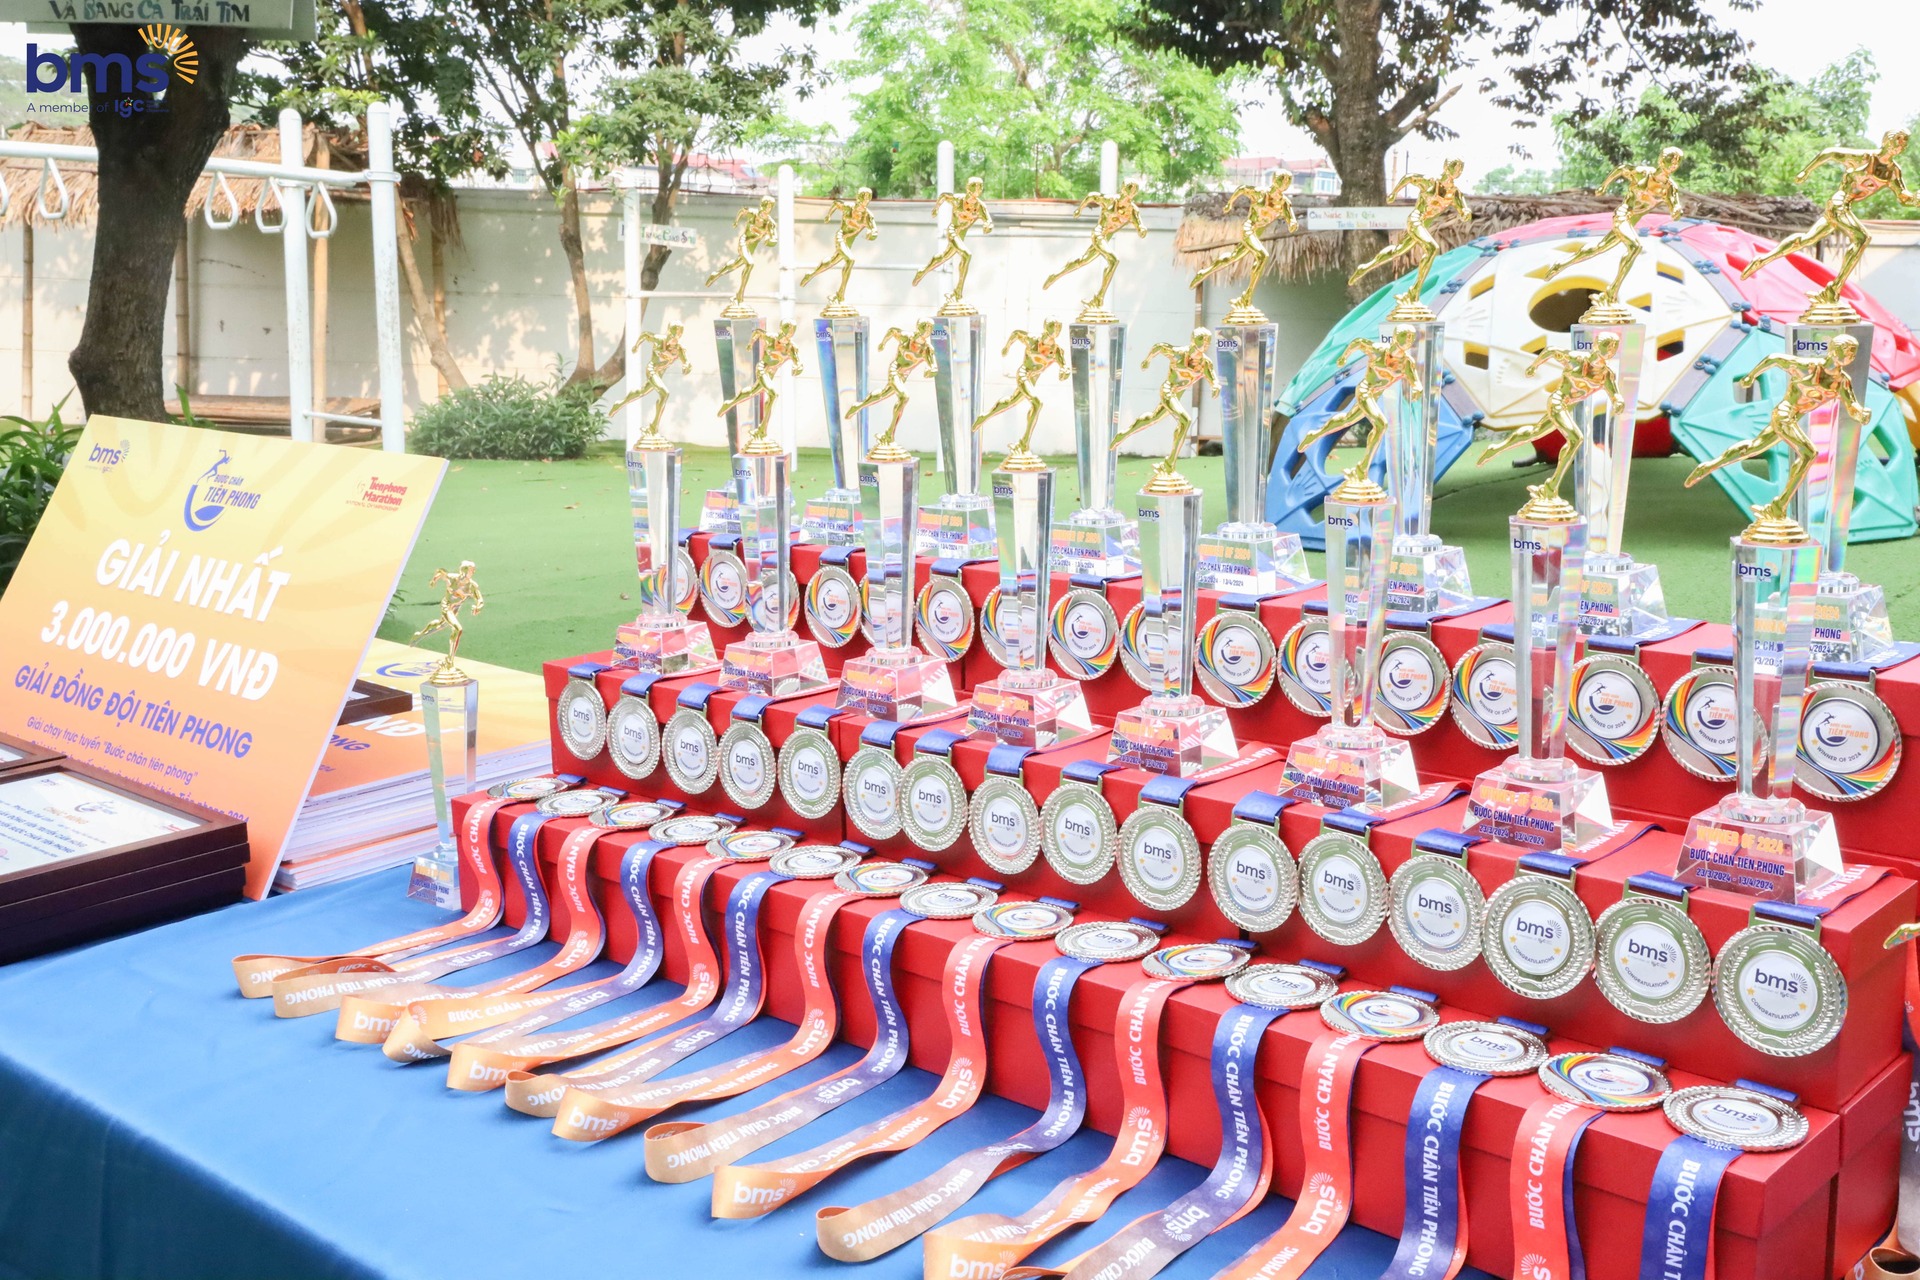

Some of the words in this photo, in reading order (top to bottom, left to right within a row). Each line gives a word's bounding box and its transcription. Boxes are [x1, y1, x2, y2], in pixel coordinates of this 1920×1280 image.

[1072, 336, 1090, 345] bms
[1217, 338, 1238, 348] bms
[1797, 340, 1828, 350] bms
[88, 443, 122, 465] bms
[859, 474, 878, 483] bms
[993, 485, 1013, 495] bms
[203, 485, 228, 503] TIÊN
[225, 491, 261, 509] PHONG
[362, 490, 403, 506] Marathon
[1138, 508, 1160, 518] bms
[1328, 514, 1354, 527] bms
[1513, 538, 1542, 551] bms
[95, 529, 180, 598] GIẢI
[174, 545, 291, 623] NHẤT
[1738, 563, 1772, 579] bms
[1591, 601, 1614, 613] PHONG
[1814, 627, 1841, 640] PHONG
[41, 600, 197, 679] 3.000.000
[198, 639, 279, 701] VNĐ
[15, 662, 53, 695] GIẢI
[51, 668, 104, 711] ĐỒNG
[104, 690, 141, 727] ĐỘI
[140, 700, 181, 735] TIÊN
[179, 714, 252, 758] PHONG
[573, 708, 590, 721] bms
[1588, 713, 1607, 729] WINNER
[1615, 720, 1627, 729] 2024
[624, 725, 642, 740] bms
[1698, 729, 1718, 745] WINNER
[27, 716, 44, 730] Giải
[43, 722, 62, 740] chạy
[63, 728, 79, 744] trực
[79, 733, 101, 750] tuyến
[127, 750, 147, 766] chân
[165, 764, 198, 786] phong"
[680, 739, 699, 753] bms
[1817, 746, 1837, 762] WINNER
[1848, 751, 1862, 762] 2024
[735, 752, 755, 766] bms
[798, 760, 818, 775] bms
[864, 779, 886, 795] bms
[918, 789, 942, 804] bms
[991, 811, 1015, 827] bms
[1065, 818, 1090, 836] bms
[1530, 816, 1555, 832] PHONG
[1144, 842, 1172, 860] bms
[1236, 861, 1266, 880] bms
[1323, 870, 1354, 891] bms
[1696, 868, 1731, 883] 23/3/2024
[1738, 875, 1775, 891] 13/4/2024
[1756, 859, 1785, 877] PHONG
[739, 877, 765, 916] BƯỚC
[1418, 894, 1452, 914] bms
[462, 897, 493, 928] bms
[735, 912, 747, 948] CHÂN
[804, 906, 823, 949] CHÂN
[872, 917, 897, 956] BƯỚC
[1516, 917, 1554, 939] bms
[554, 940, 588, 969] bms
[739, 950, 752, 975] TIÊN
[1512, 945, 1555, 964] CONGRATULATIONS
[1628, 938, 1668, 963] bms
[623, 949, 655, 987] PHONG
[803, 950, 820, 989] BƯỚC
[871, 958, 887, 997] CHÂN
[954, 953, 975, 997] CHÂN
[1625, 966, 1669, 988] CONGRATULATIONS
[1754, 968, 1798, 993] bms
[285, 987, 335, 1005] PHONG
[682, 971, 711, 1007] bms
[723, 975, 750, 1023] PHONG
[1046, 967, 1067, 1009] BƯỚC
[447, 1008, 484, 1023] BƯỚC
[485, 1001, 523, 1017] CHÂN
[881, 999, 896, 1026] TIÊN
[954, 999, 972, 1037] BƯỚC
[1129, 997, 1149, 1043] CHÂN
[1751, 997, 1800, 1020] CONGRATULATIONS
[791, 1019, 825, 1056] bms
[1045, 1014, 1064, 1055] CHÂN
[1227, 1014, 1255, 1059] BƯỚC
[1469, 1036, 1507, 1052] bms
[871, 1026, 899, 1074] PHONG
[733, 1062, 780, 1084] PHONG
[1057, 1055, 1074, 1088] TIÊN
[1129, 1045, 1147, 1086] BƯỚC
[937, 1068, 973, 1109] bms
[1226, 1062, 1243, 1108] CHÂN
[1316, 1055, 1338, 1105] CHÂN
[568, 1107, 618, 1132] bms
[1043, 1091, 1075, 1138] PHONG
[1429, 1081, 1456, 1133] BƯỚC
[1712, 1104, 1759, 1122] bms
[890, 1117, 929, 1143] PHONG
[1232, 1110, 1250, 1144] TIÊN
[1313, 1107, 1333, 1152] BƯỚC
[1121, 1118, 1153, 1167] bms
[1528, 1120, 1556, 1177] CHÂN
[667, 1144, 713, 1169] PHONG
[1422, 1135, 1440, 1183] CHÂN
[1215, 1146, 1249, 1201] PHONG
[733, 1181, 785, 1205] bms
[1087, 1177, 1120, 1204] PHONG
[1671, 1158, 1702, 1218] BƯỚC
[1299, 1185, 1336, 1236] bms
[1422, 1185, 1441, 1221] TIÊN
[1524, 1179, 1545, 1231] BƯỚC
[843, 1216, 894, 1248] PHONG
[1165, 1205, 1211, 1235] bms
[1408, 1222, 1439, 1277] PHONG
[1665, 1219, 1688, 1273] CHÂN
[950, 1254, 1005, 1279] bms
[1261, 1246, 1299, 1275] PHONG
